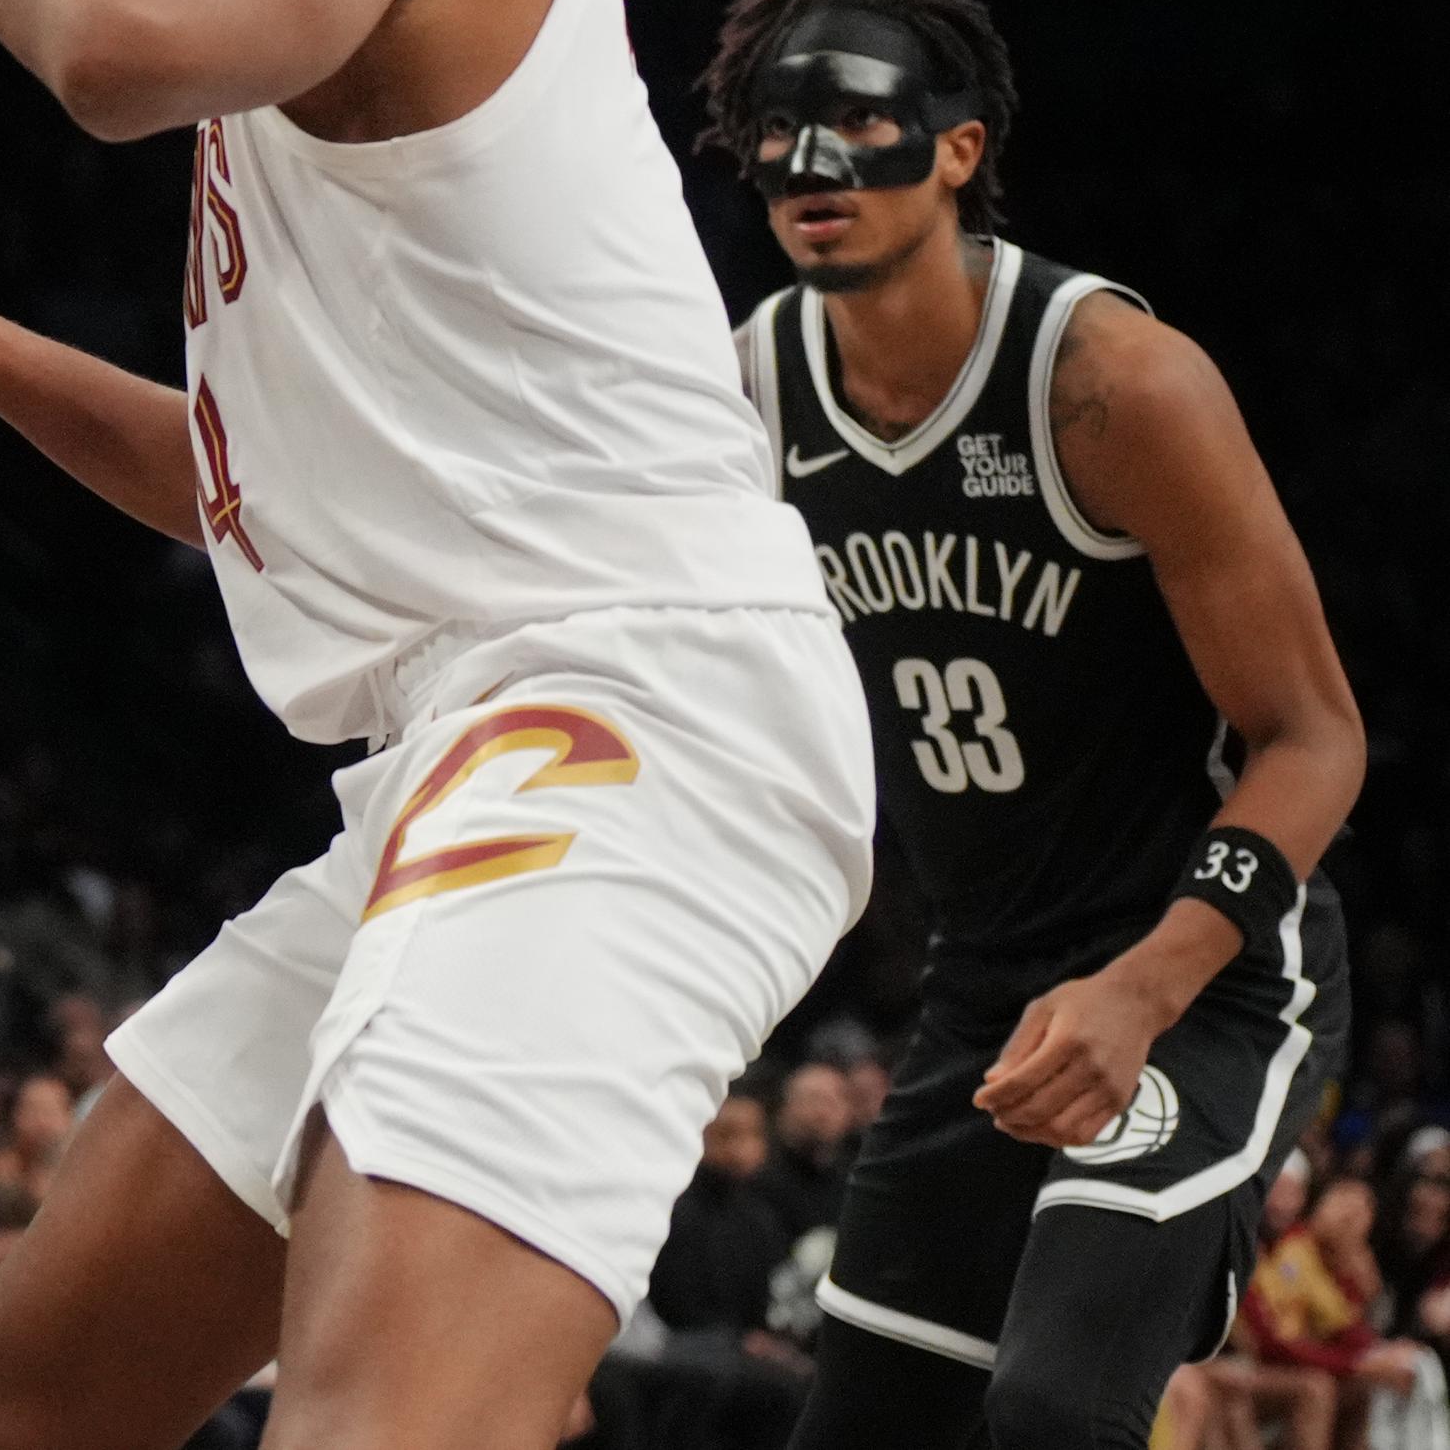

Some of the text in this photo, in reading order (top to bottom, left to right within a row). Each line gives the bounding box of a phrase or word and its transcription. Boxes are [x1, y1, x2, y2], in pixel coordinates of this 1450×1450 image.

[184, 117, 248, 330] VS
[958, 433, 1002, 456] GET
[960, 453, 1029, 477] YOUR
[962, 474, 1035, 498] GUIDE
[814, 529, 1083, 637] ROOKLYN
[892, 657, 1026, 794] 33
[1194, 840, 1259, 893] 33
